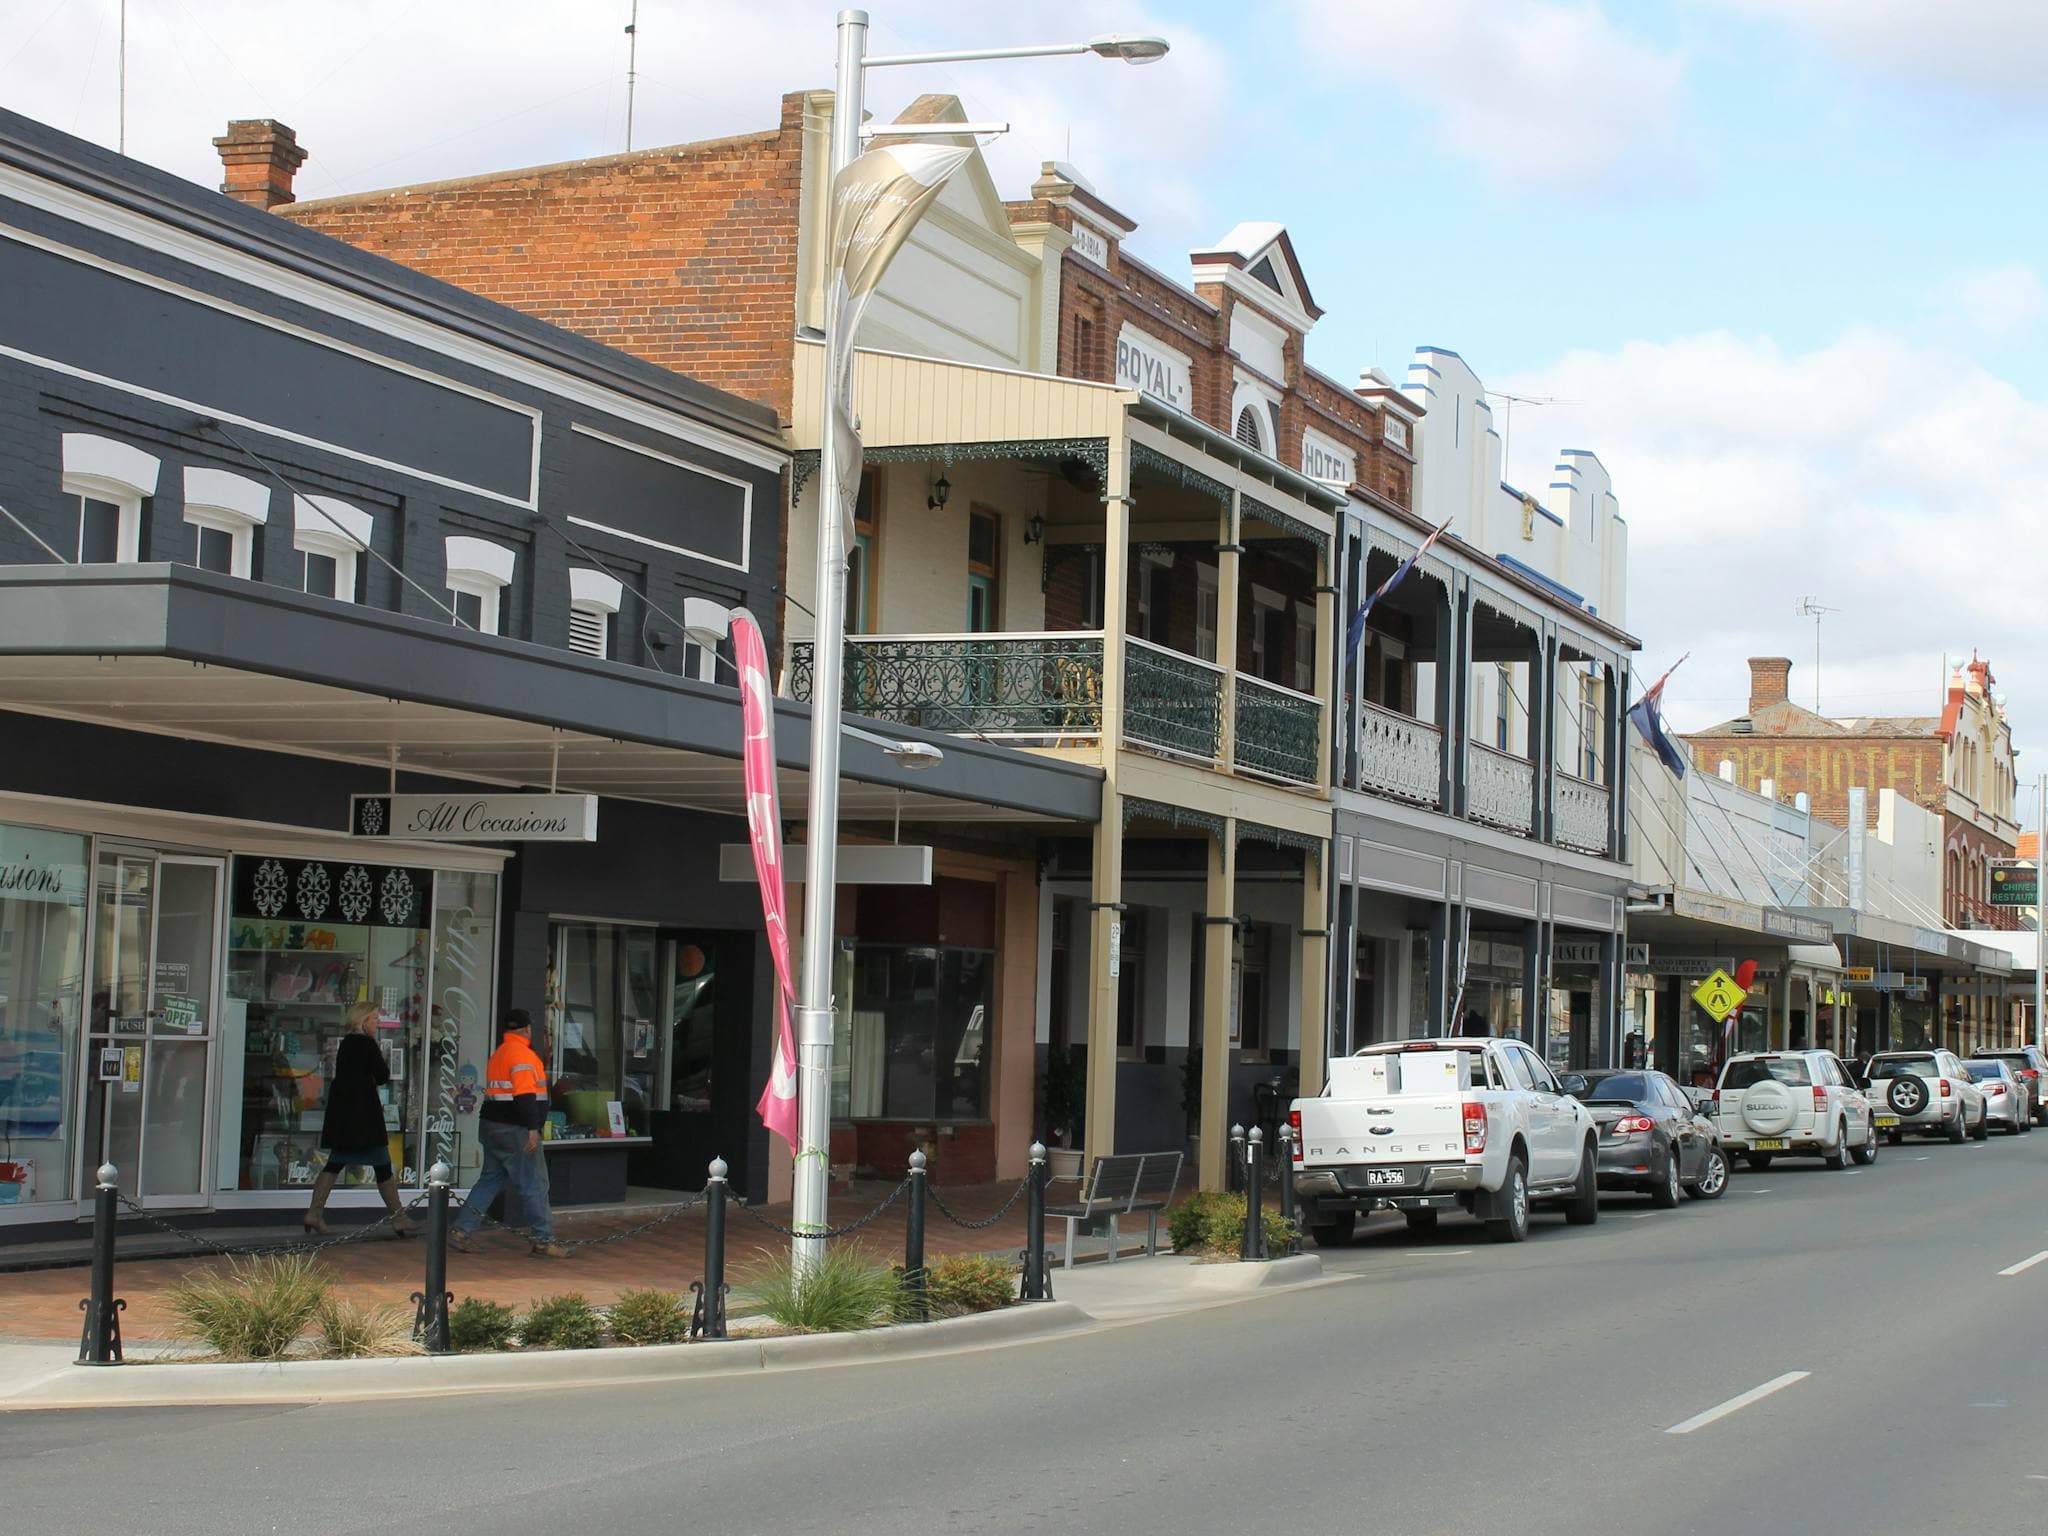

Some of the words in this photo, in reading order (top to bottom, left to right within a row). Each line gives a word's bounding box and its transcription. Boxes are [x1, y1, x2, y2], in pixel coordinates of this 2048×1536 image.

[408, 800, 460, 833] All
[462, 800, 568, 833] Occasions
[2001, 883, 2037, 892] CHINES
[165, 1009, 194, 1028] OPEN
[120, 1021, 144, 1032] PUSH
[1310, 1142, 1458, 1156] RANGER
